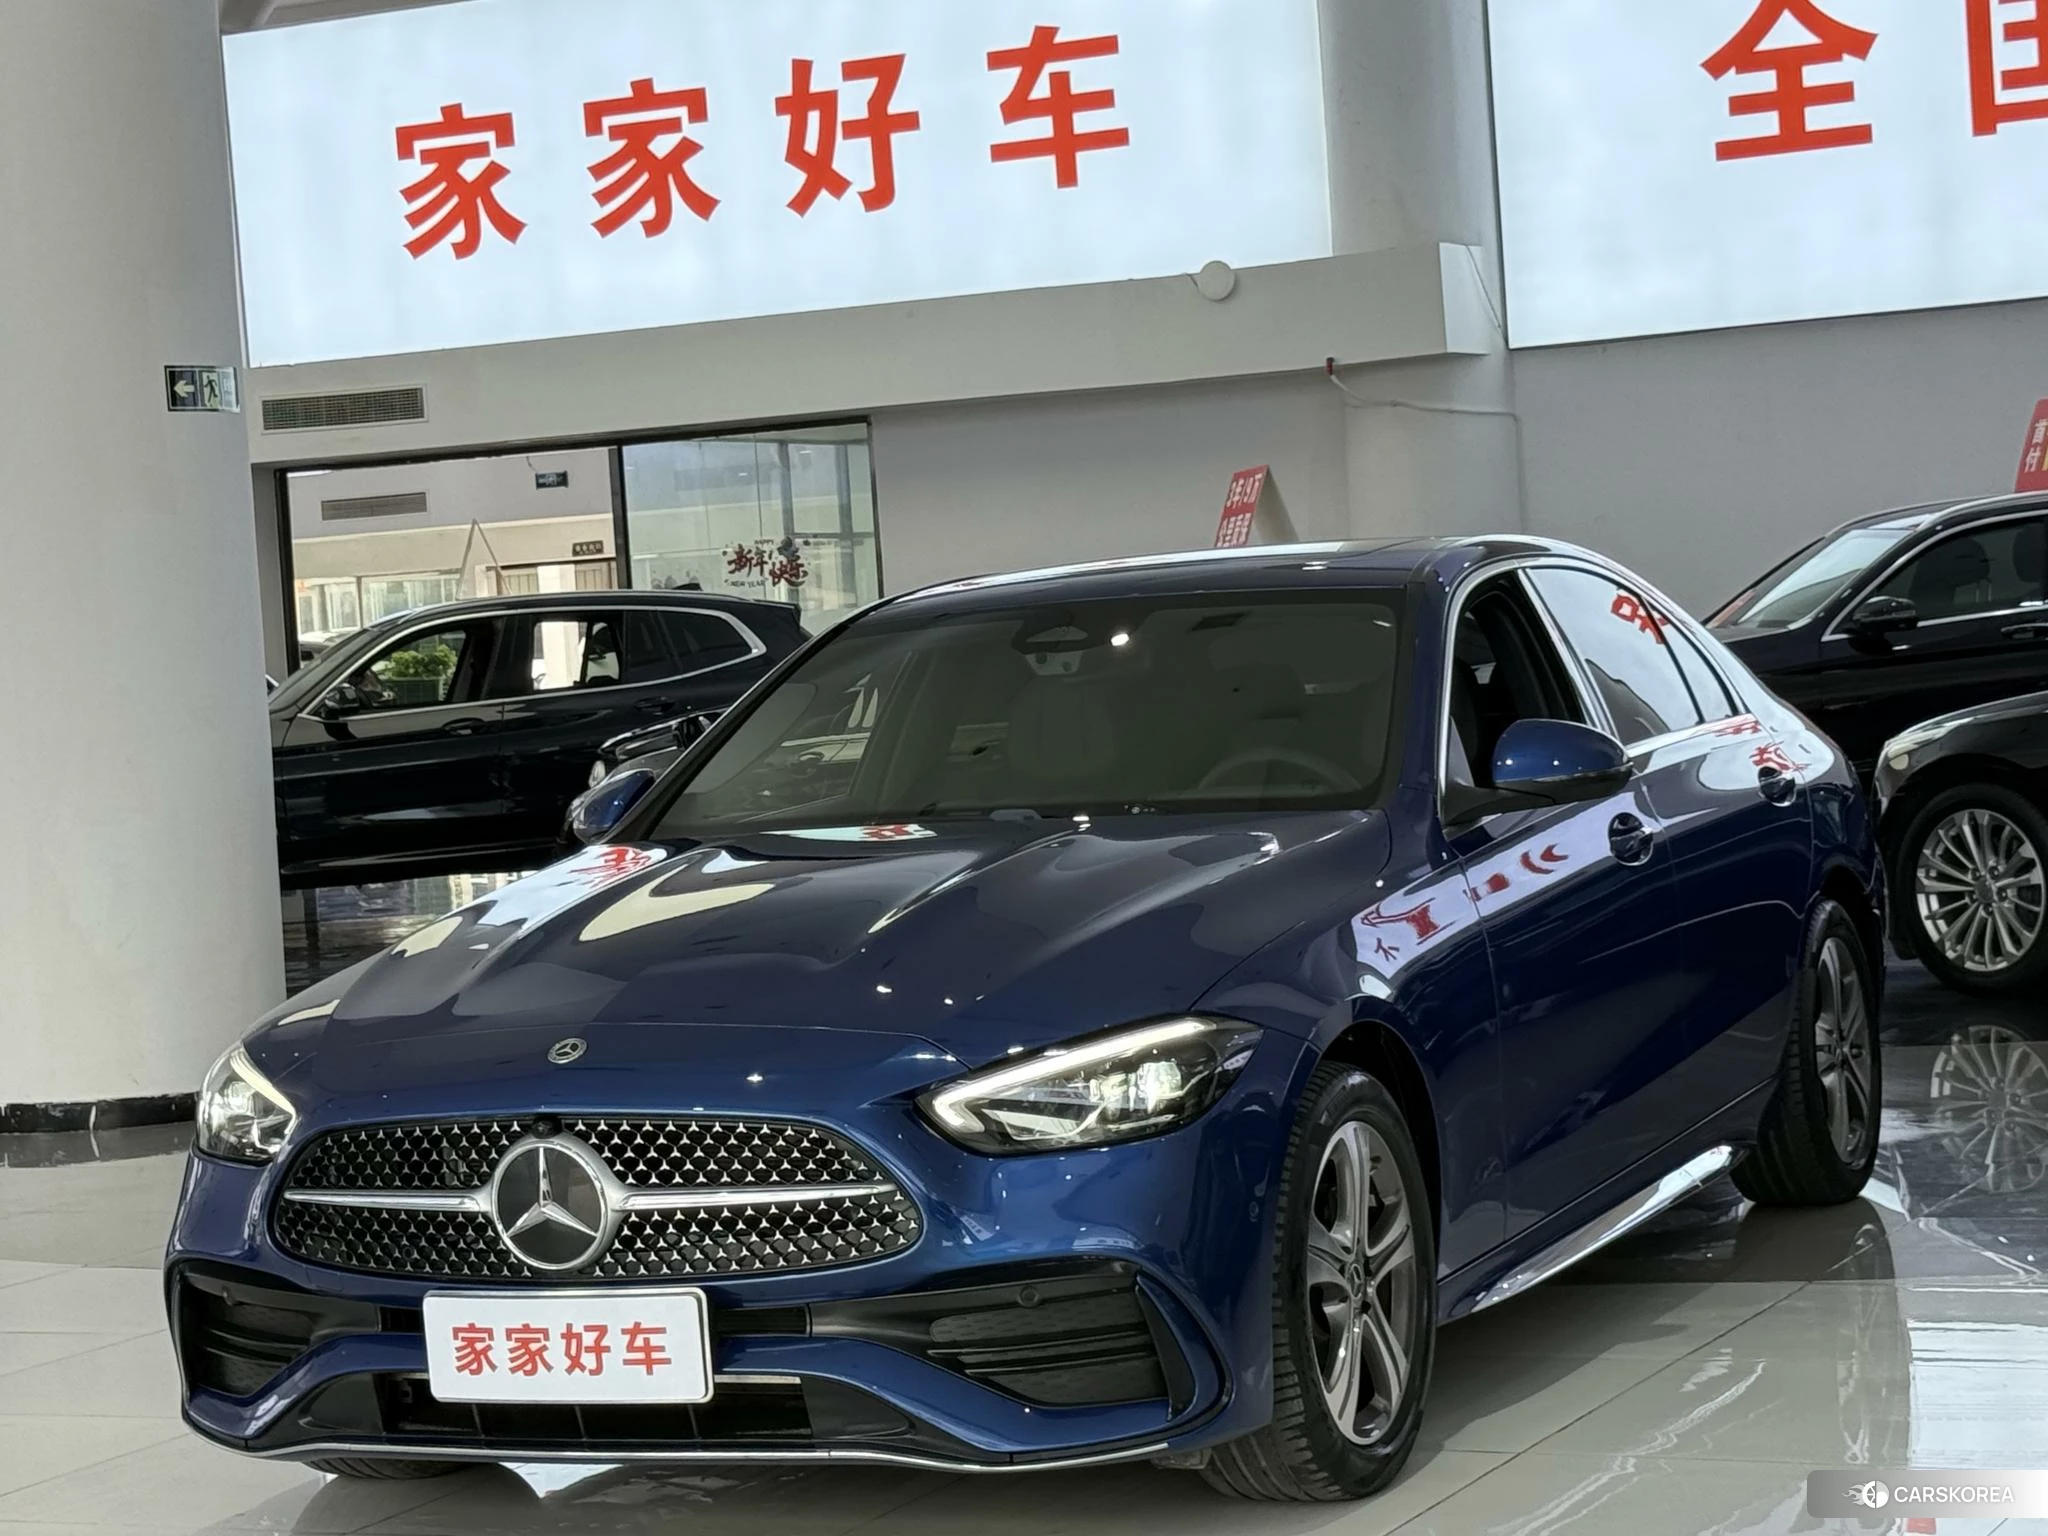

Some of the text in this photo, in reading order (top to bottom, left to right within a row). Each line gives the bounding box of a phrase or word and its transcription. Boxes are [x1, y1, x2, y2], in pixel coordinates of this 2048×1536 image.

[395, 26, 1128, 258] 家家好车
[452, 1322, 672, 1376] 家家好车
